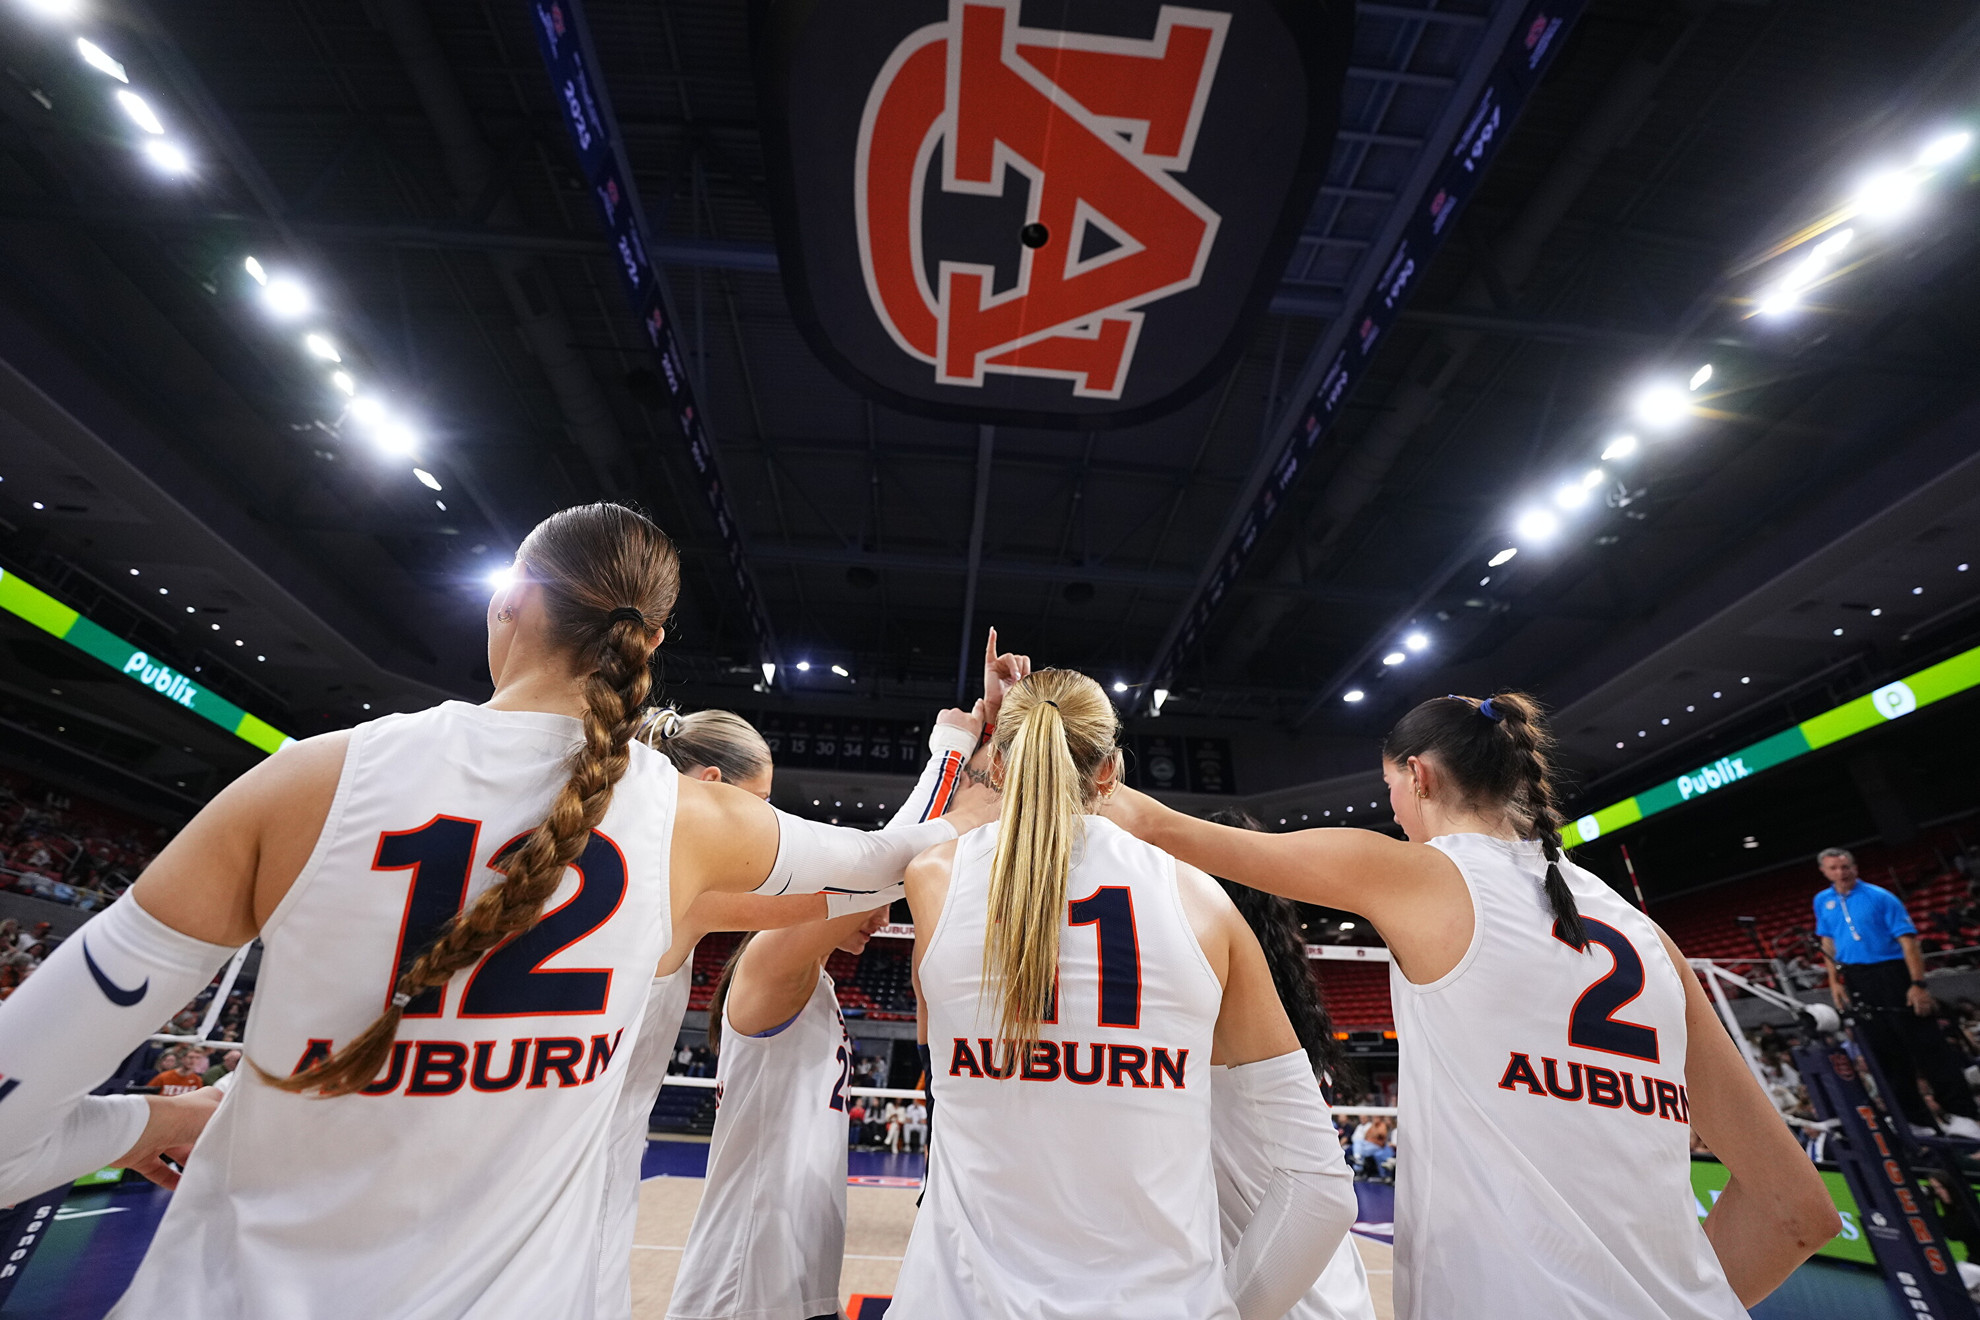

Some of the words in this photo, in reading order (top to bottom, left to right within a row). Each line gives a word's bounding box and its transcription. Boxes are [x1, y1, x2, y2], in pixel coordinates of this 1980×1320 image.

[123, 651, 197, 707] Publix
[791, 739, 806, 754] 15
[816, 741, 835, 756] 30
[843, 743, 862, 757] 34
[870, 745, 889, 759] 45
[901, 747, 914, 760] 11
[1677, 757, 1749, 800] Publix
[371, 813, 629, 1019] 12
[994, 885, 1142, 1029] 1
[1552, 914, 1660, 1064] 2
[948, 1038, 1189, 1090] AUBURN
[1856, 1106, 1948, 1275] TIGERS
